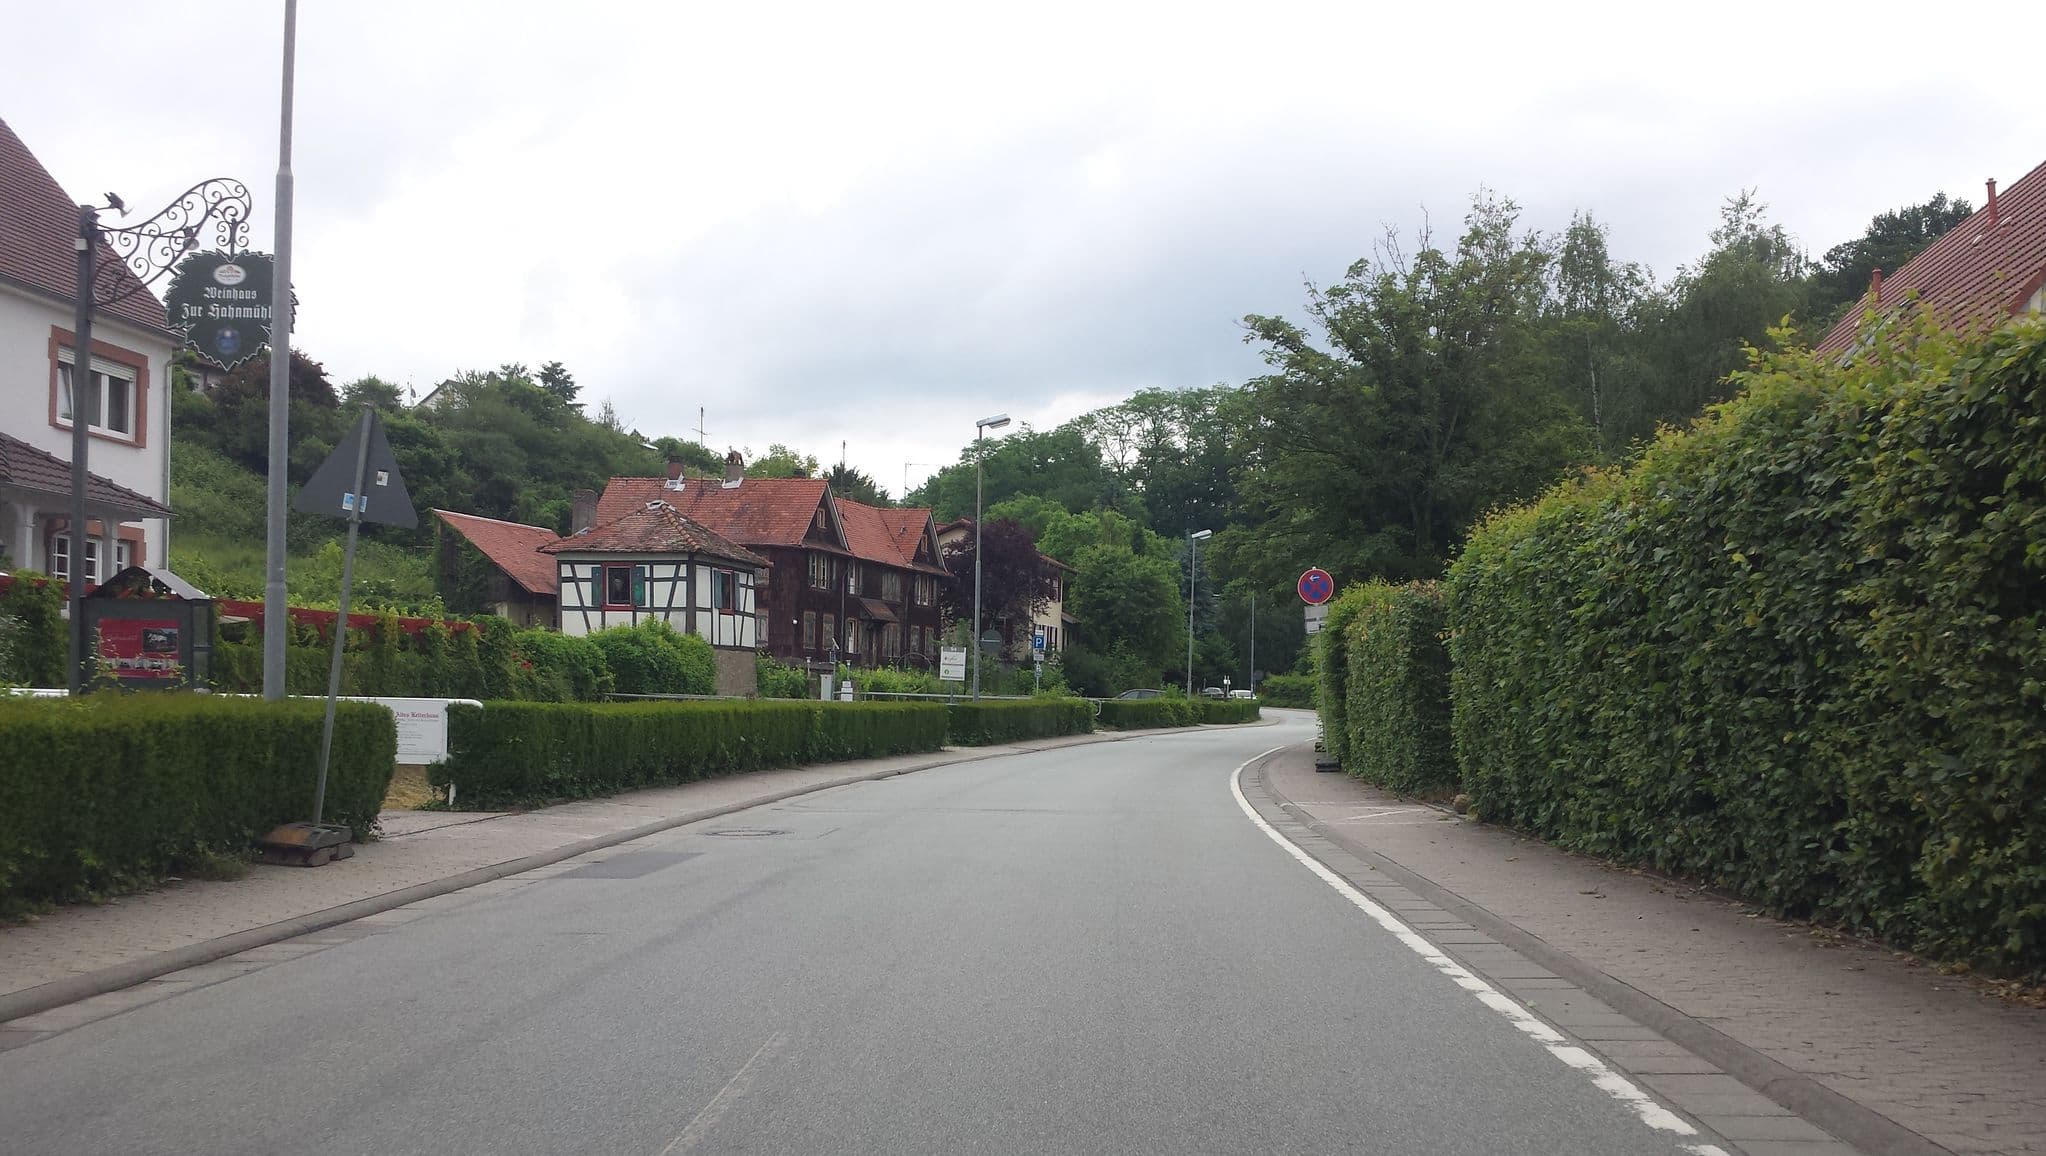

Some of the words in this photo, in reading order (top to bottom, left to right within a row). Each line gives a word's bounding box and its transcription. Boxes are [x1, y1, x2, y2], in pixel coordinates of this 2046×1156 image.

[203, 286, 257, 300] Weinhaus
[181, 302, 203, 319] Zur
[208, 303, 272, 320] Hahnmühl
[1035, 637, 1043, 648] P
